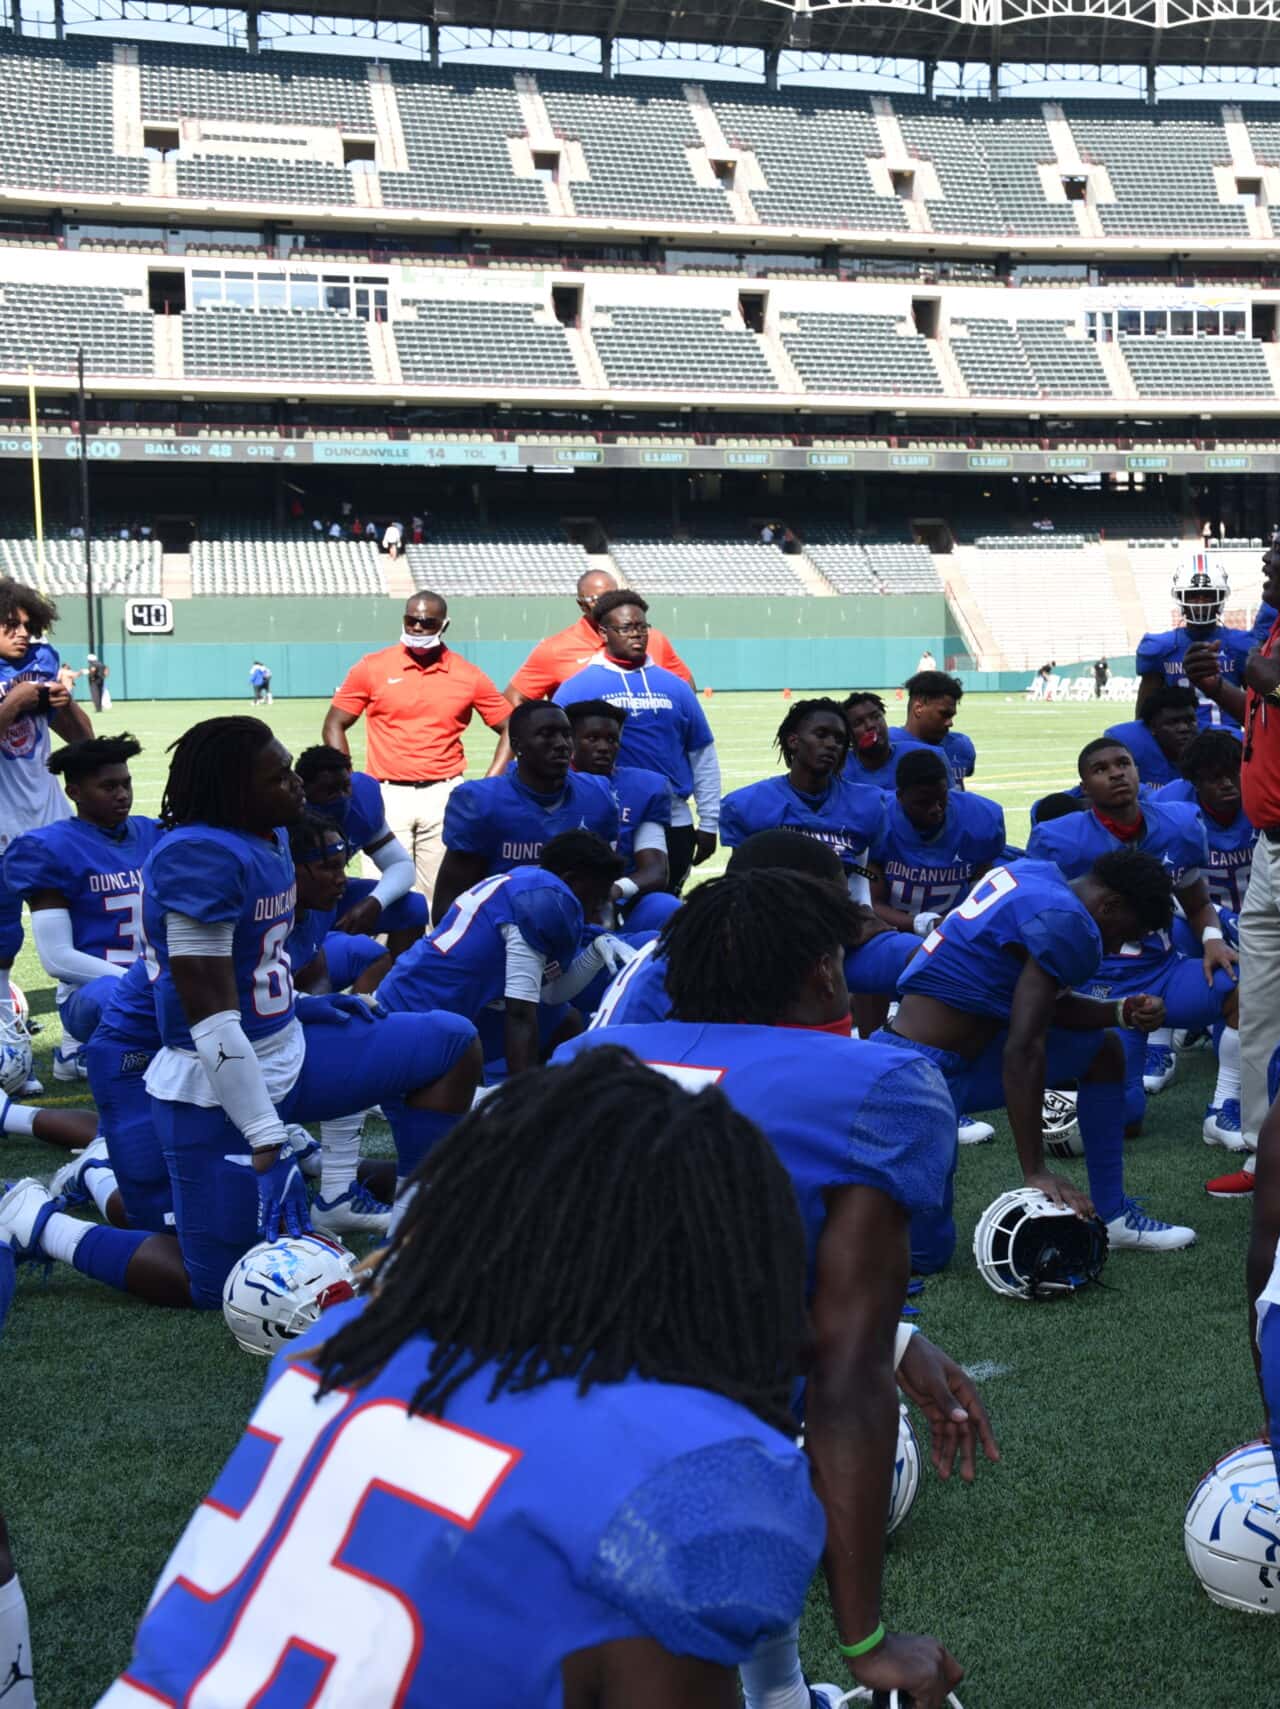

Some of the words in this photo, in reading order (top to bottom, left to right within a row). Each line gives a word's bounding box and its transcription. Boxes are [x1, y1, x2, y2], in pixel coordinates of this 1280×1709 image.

[144, 443, 177, 455] BALL
[180, 445, 200, 456] ON
[208, 444, 233, 457] 48
[284, 446, 296, 458] 4
[324, 448, 409, 458] DUNCANVILLE
[134, 605, 165, 626] 40
[885, 860, 973, 883] DUNCANVILLE
